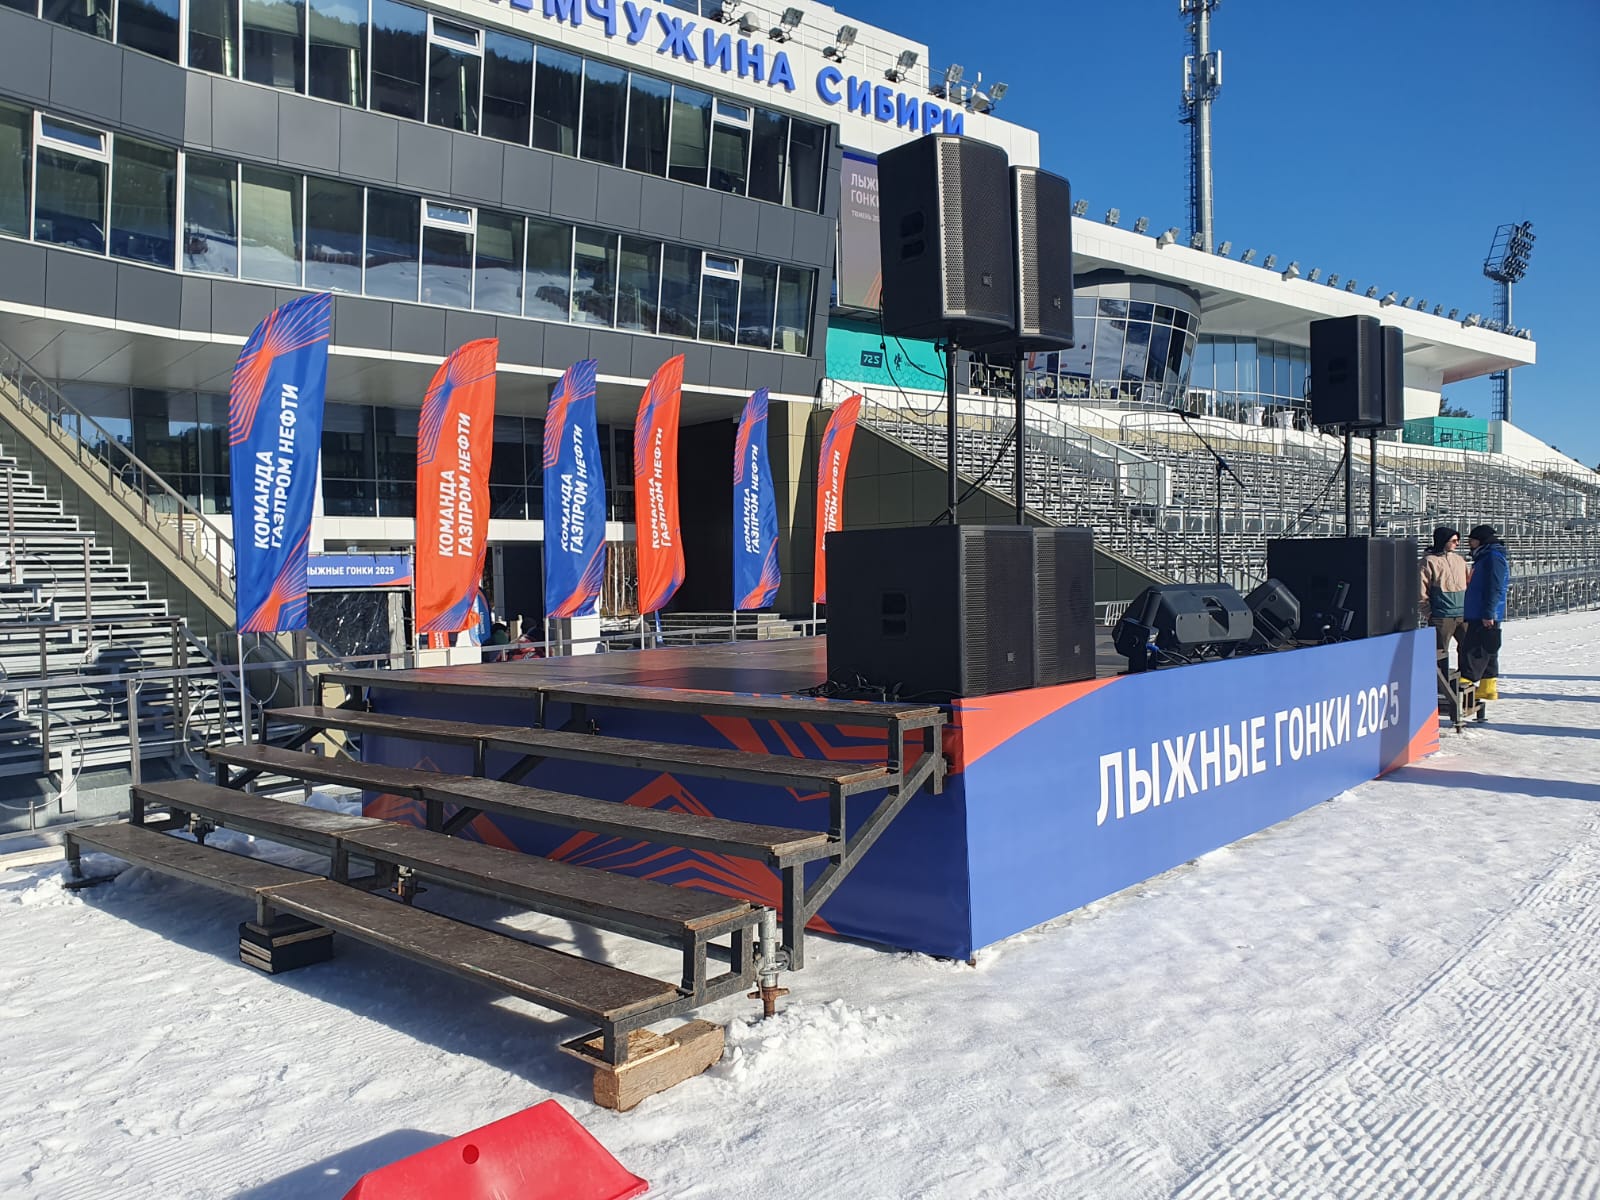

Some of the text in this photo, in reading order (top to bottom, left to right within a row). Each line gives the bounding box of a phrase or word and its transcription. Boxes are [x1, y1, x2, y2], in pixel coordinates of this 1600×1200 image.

[489, 0, 964, 136] МЧУЖИНА СИБИРИ
[254, 451, 275, 549] КОМАНДА
[271, 384, 299, 548] ГАЗПРОМ НЕФТИ
[439, 470, 457, 557] КОМАНДА
[456, 412, 473, 557] ГАЗПРОМ НЕФТИ
[560, 474, 574, 552] КОМАНДА
[570, 424, 588, 554] ГАЗПРОМ НЕФТИ
[648, 477, 660, 549] КОМАНДА
[653, 427, 672, 547] ГАЗПРОМ НЕФТИ
[750, 444, 760, 554] ГАЗПРОМ НЕФТИ
[831, 449, 841, 494] НЕФТИ
[346, 566, 374, 575] ГОНКИ
[375, 566, 395, 575] 2025
[743, 488, 752, 553] КОМАНДА
[1096, 681, 1400, 827] ЛЫЖНЫЕ ГОНКИ 2025
